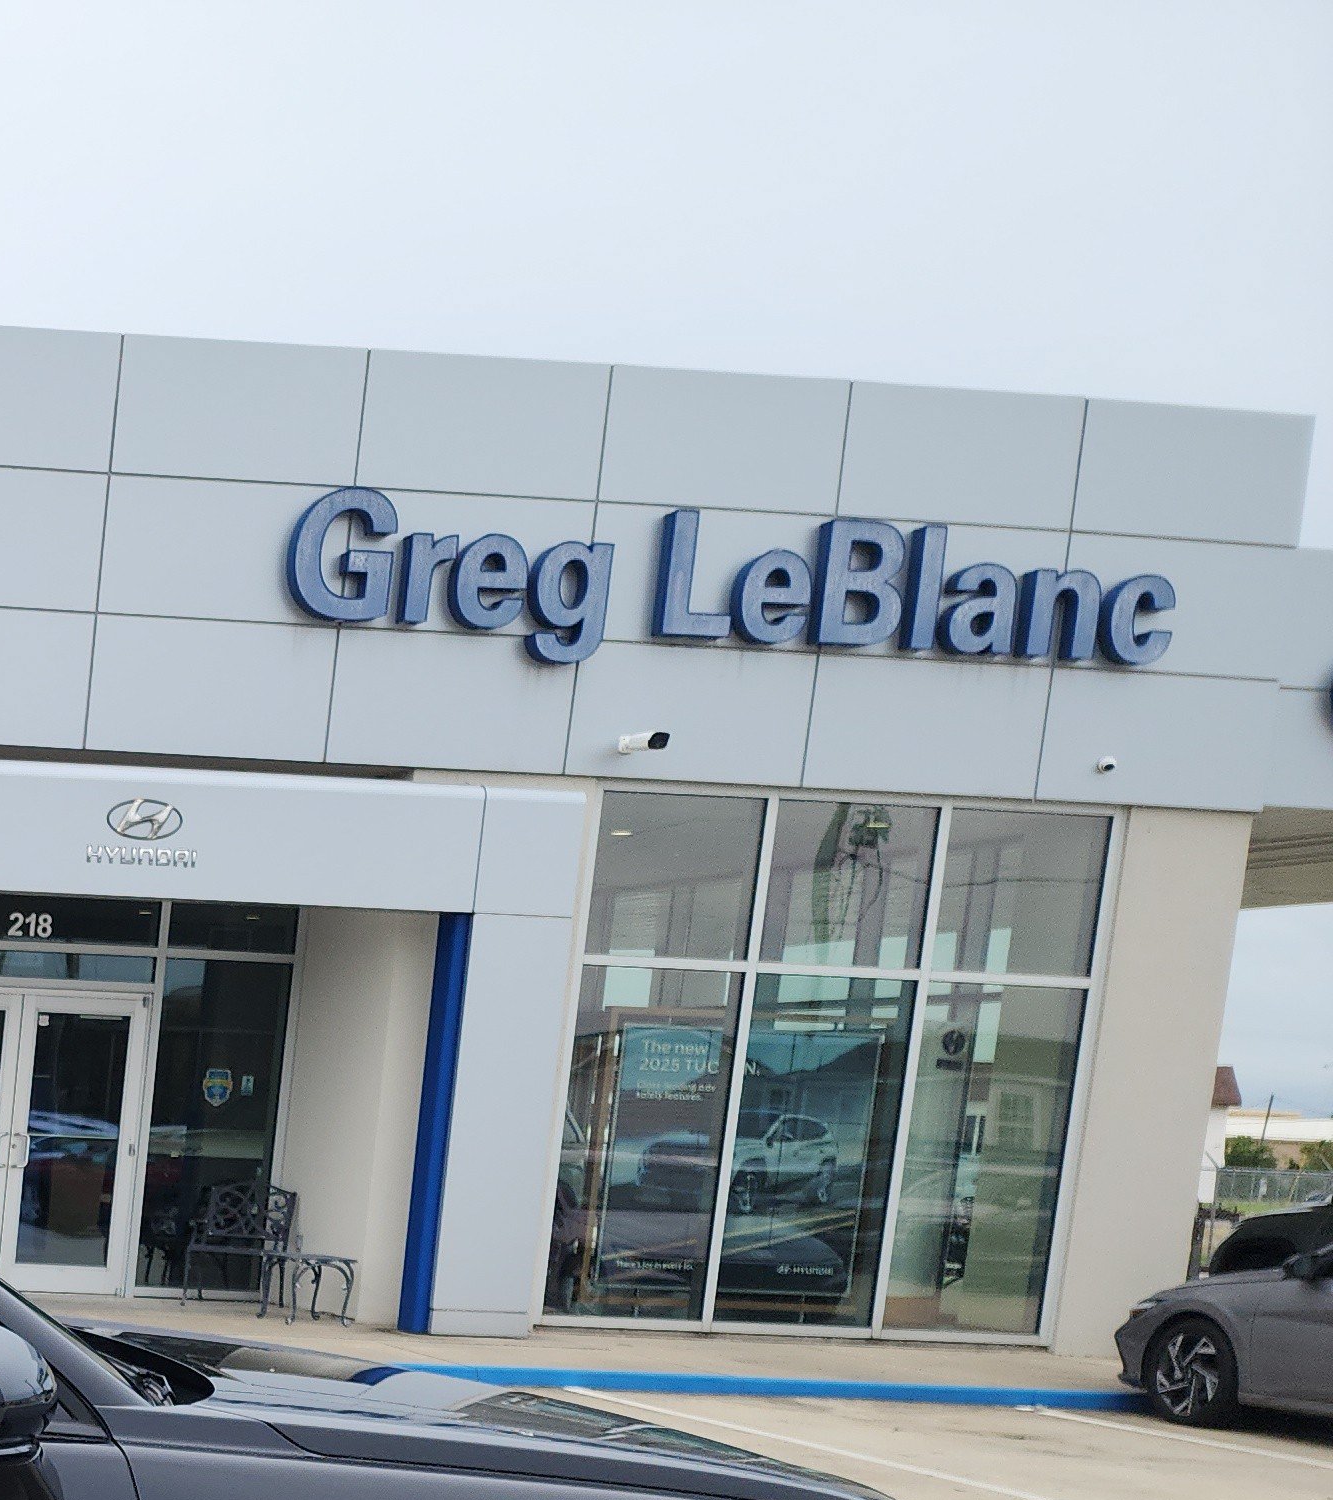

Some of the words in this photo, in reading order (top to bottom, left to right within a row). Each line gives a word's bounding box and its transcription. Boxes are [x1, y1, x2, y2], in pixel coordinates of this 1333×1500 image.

[286, 486, 615, 666] Greg
[650, 508, 1177, 667] LeBlanc
[86, 843, 197, 868] HYUNDAI
[7, 912, 53, 938] 218
[642, 1038, 671, 1054] The
[674, 1042, 709, 1055] new
[639, 1057, 681, 1073] 2025
